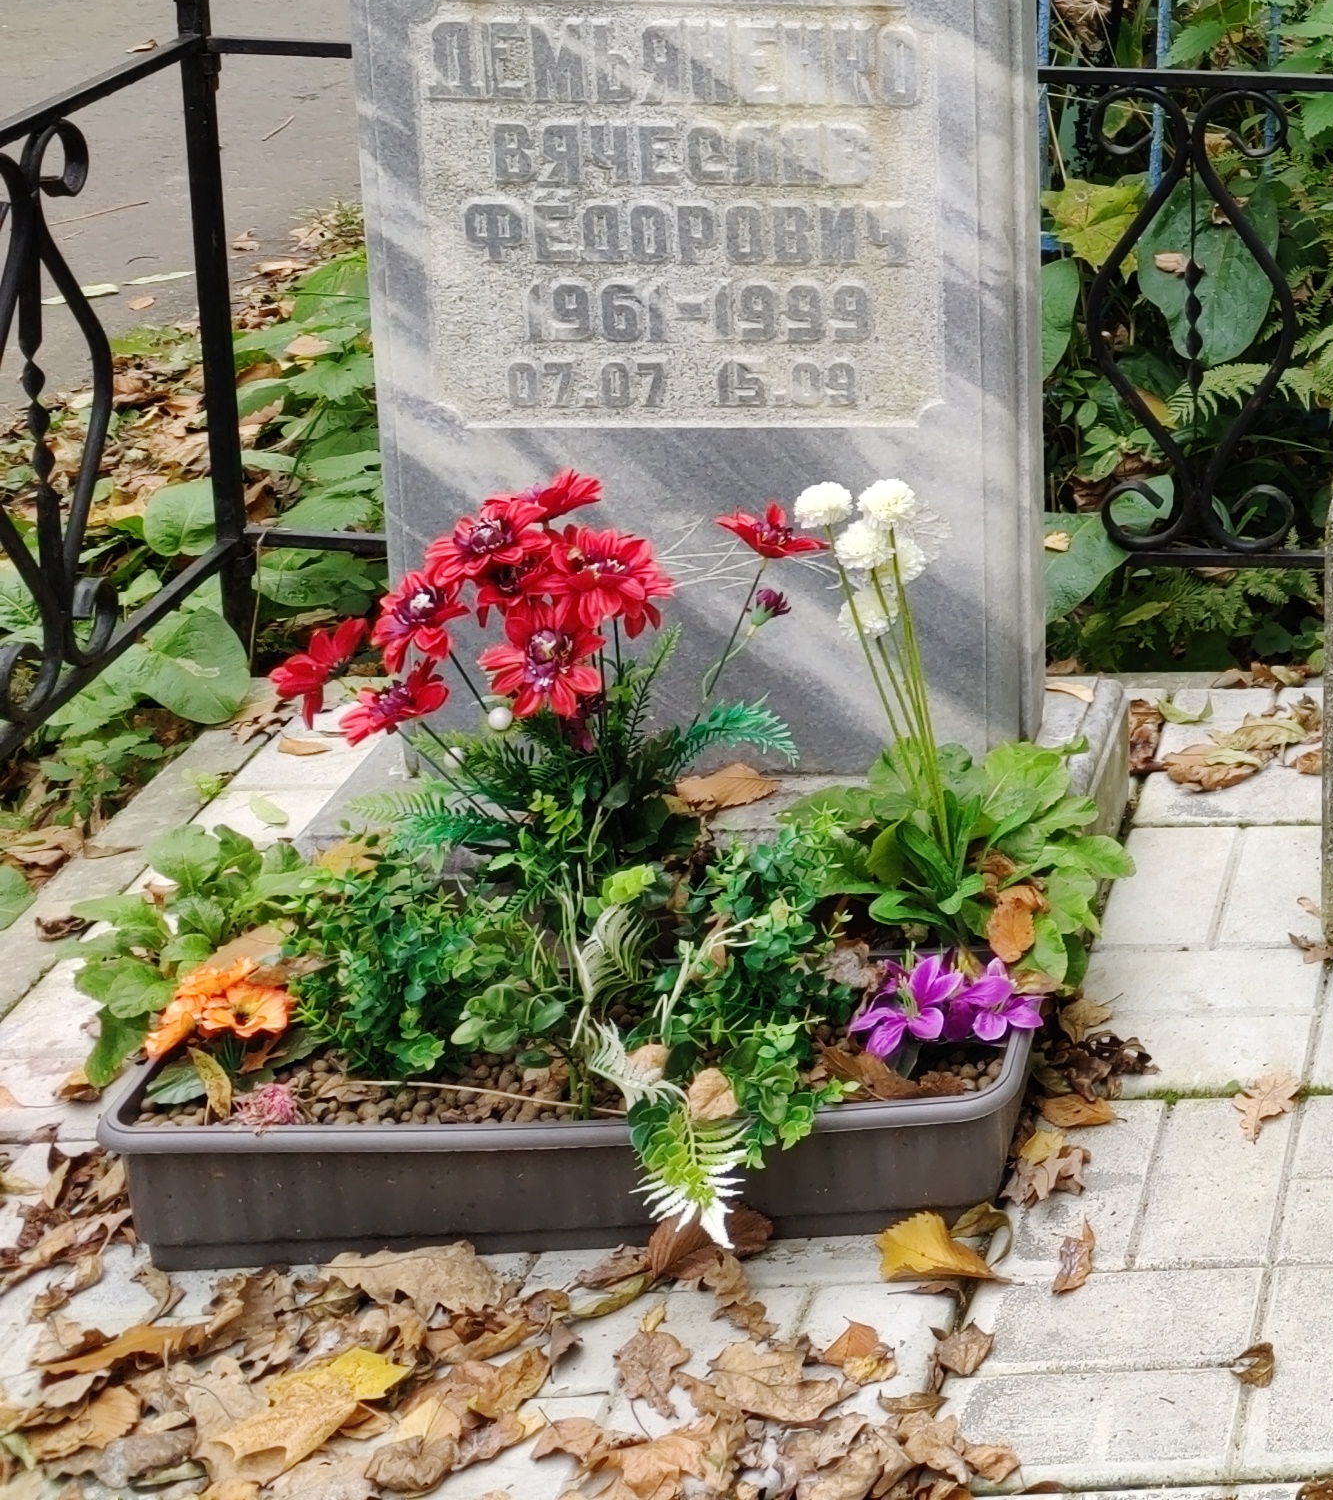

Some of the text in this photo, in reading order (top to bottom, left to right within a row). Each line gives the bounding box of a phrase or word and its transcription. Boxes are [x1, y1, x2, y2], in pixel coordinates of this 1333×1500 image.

[424, 19, 918, 106] ДЕМЬЯНЕНКО
[494, 121, 873, 188] ВЯЧЕСЛАВ
[462, 202, 911, 266] ФЕДОРОВИЧ
[527, 283, 874, 344] 1961-1999
[505, 360, 668, 408] 07.07
